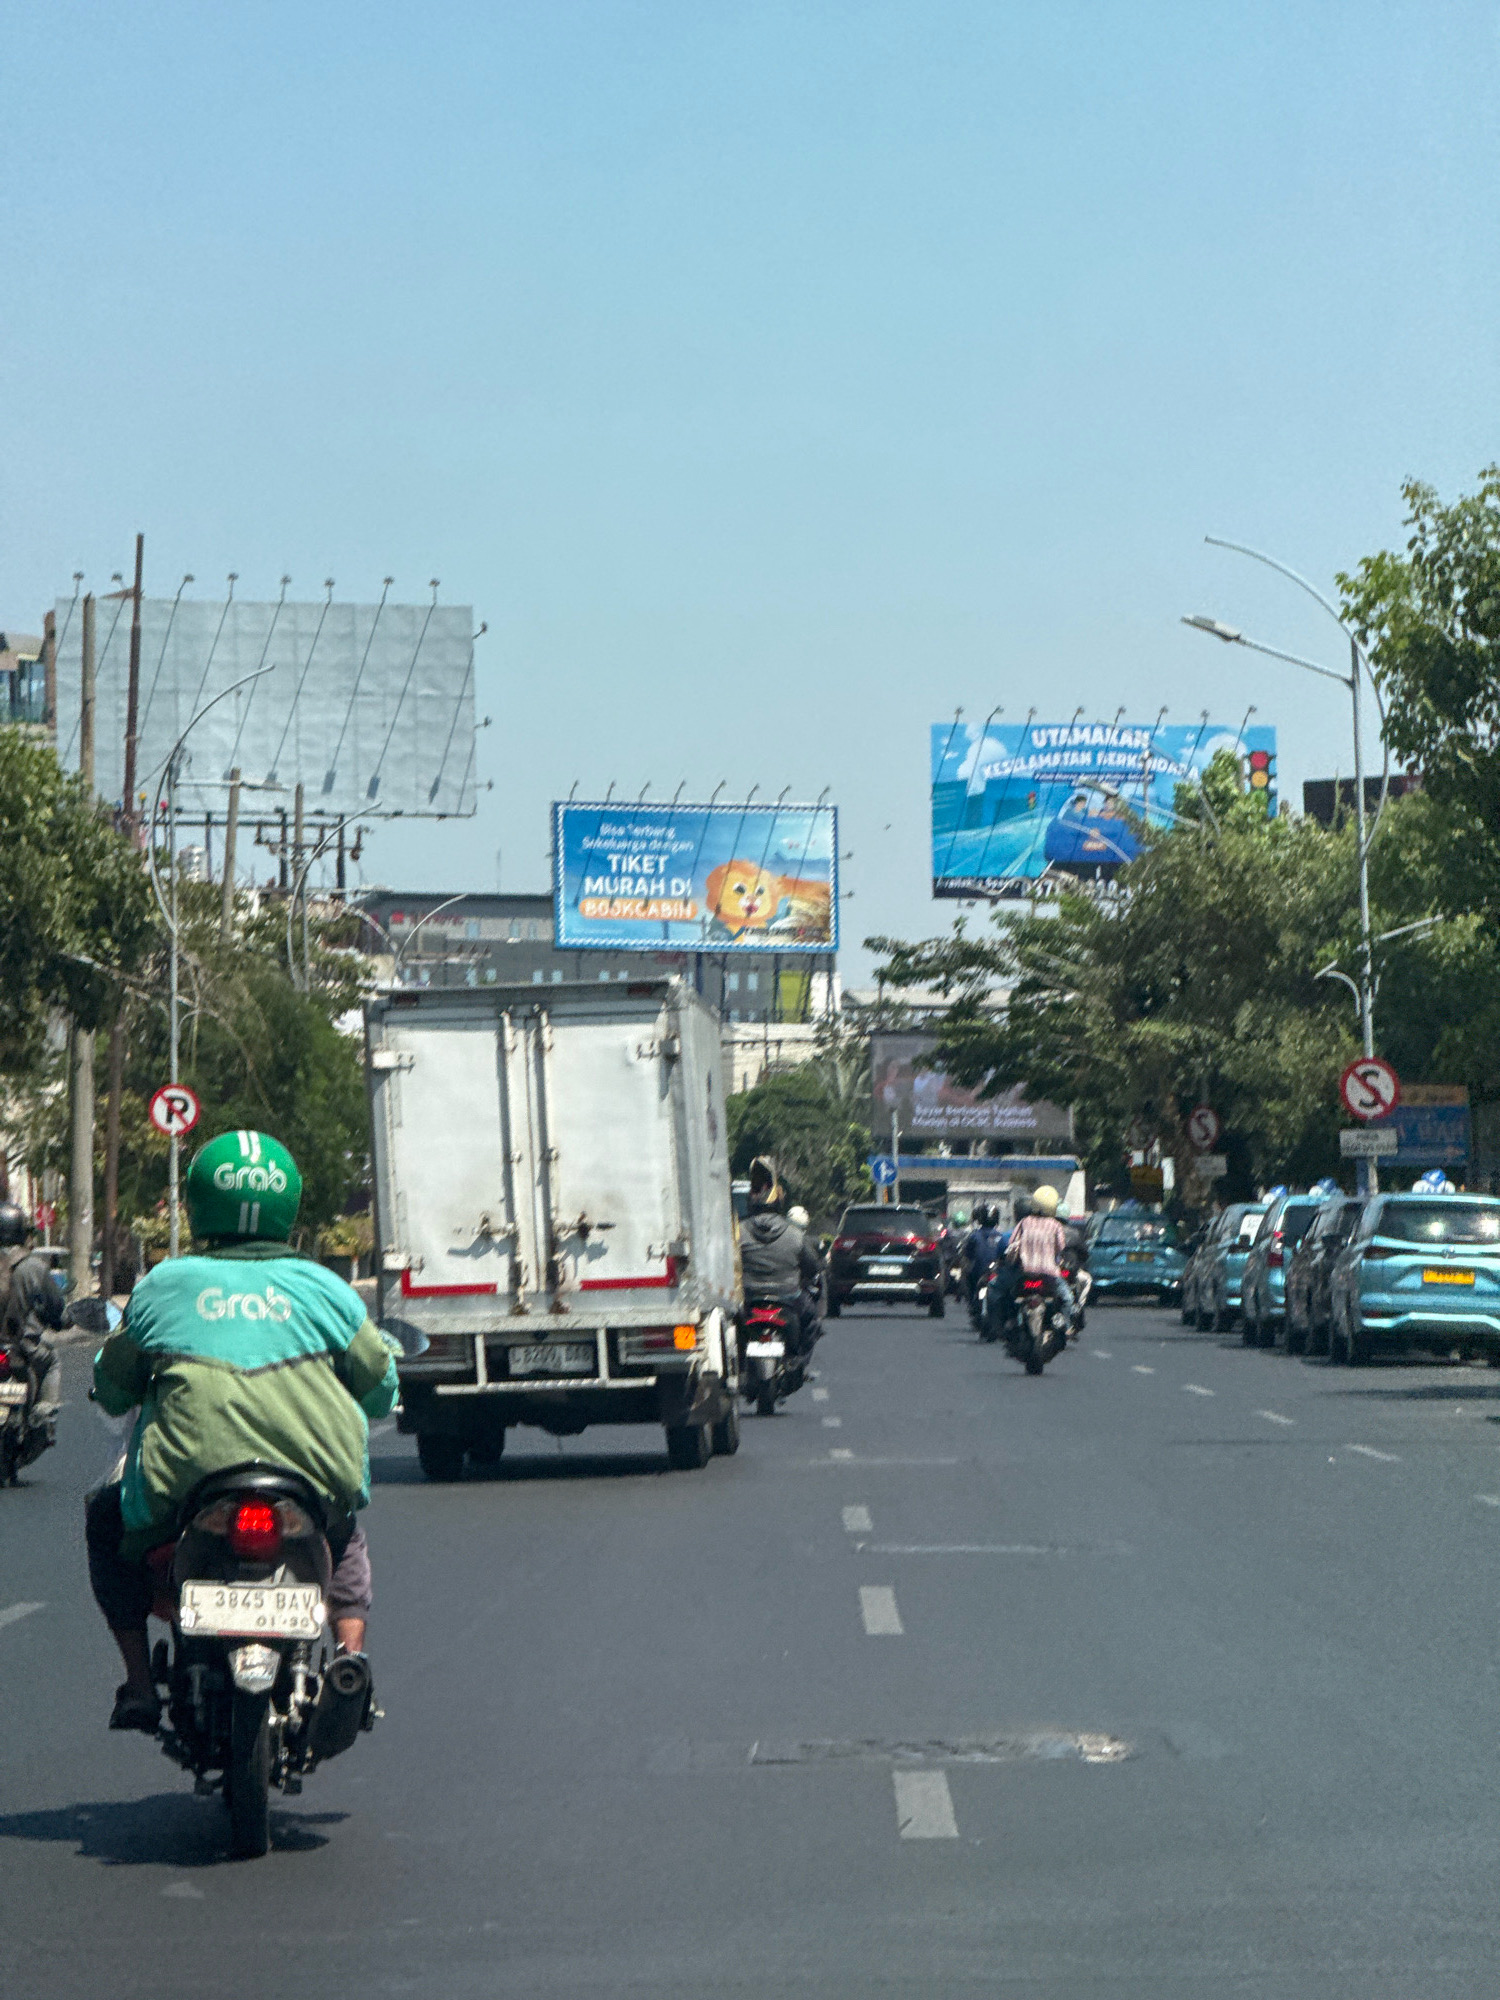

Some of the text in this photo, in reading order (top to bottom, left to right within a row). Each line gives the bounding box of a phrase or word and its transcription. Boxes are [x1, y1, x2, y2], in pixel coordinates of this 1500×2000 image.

[1031, 726, 1151, 749] UTAMAKAN
[983, 750, 1093, 779] KESELAMATAN
[606, 853, 670, 875] TIKET
[584, 875, 693, 897] MURAH DI
[584, 900, 693, 918] BOOKCABIN
[1358, 1069, 1380, 1109] S
[165, 1095, 190, 1125] P
[213, 1160, 288, 1194] Grab
[196, 1286, 292, 1323] Grab
[189, 1589, 314, 1610] L 3845 BAV
